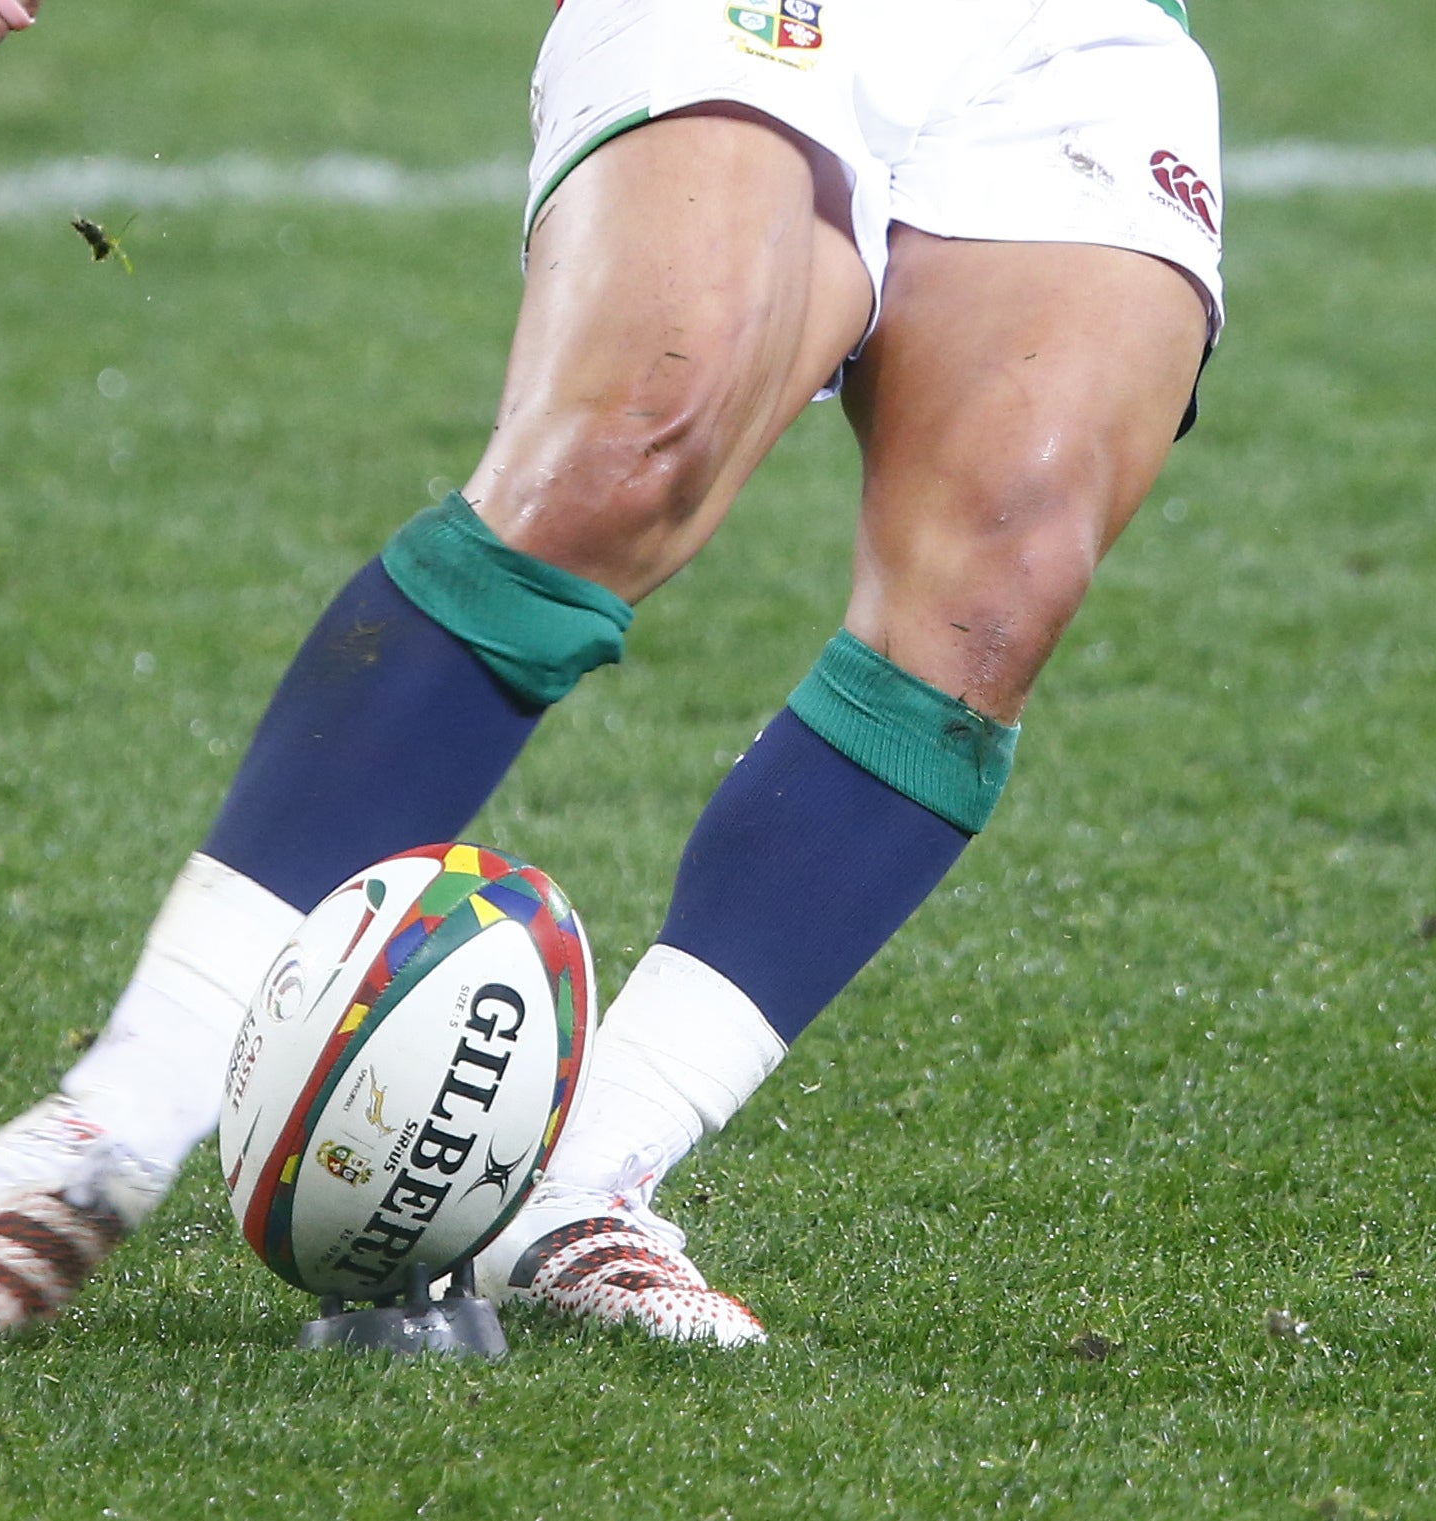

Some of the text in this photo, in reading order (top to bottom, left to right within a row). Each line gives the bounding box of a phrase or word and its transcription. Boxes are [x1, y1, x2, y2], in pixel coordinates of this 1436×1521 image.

[455, 984, 470, 1012] SIZE
[449, 1020, 459, 1028] 5
[333, 982, 526, 1286] GILBERT
